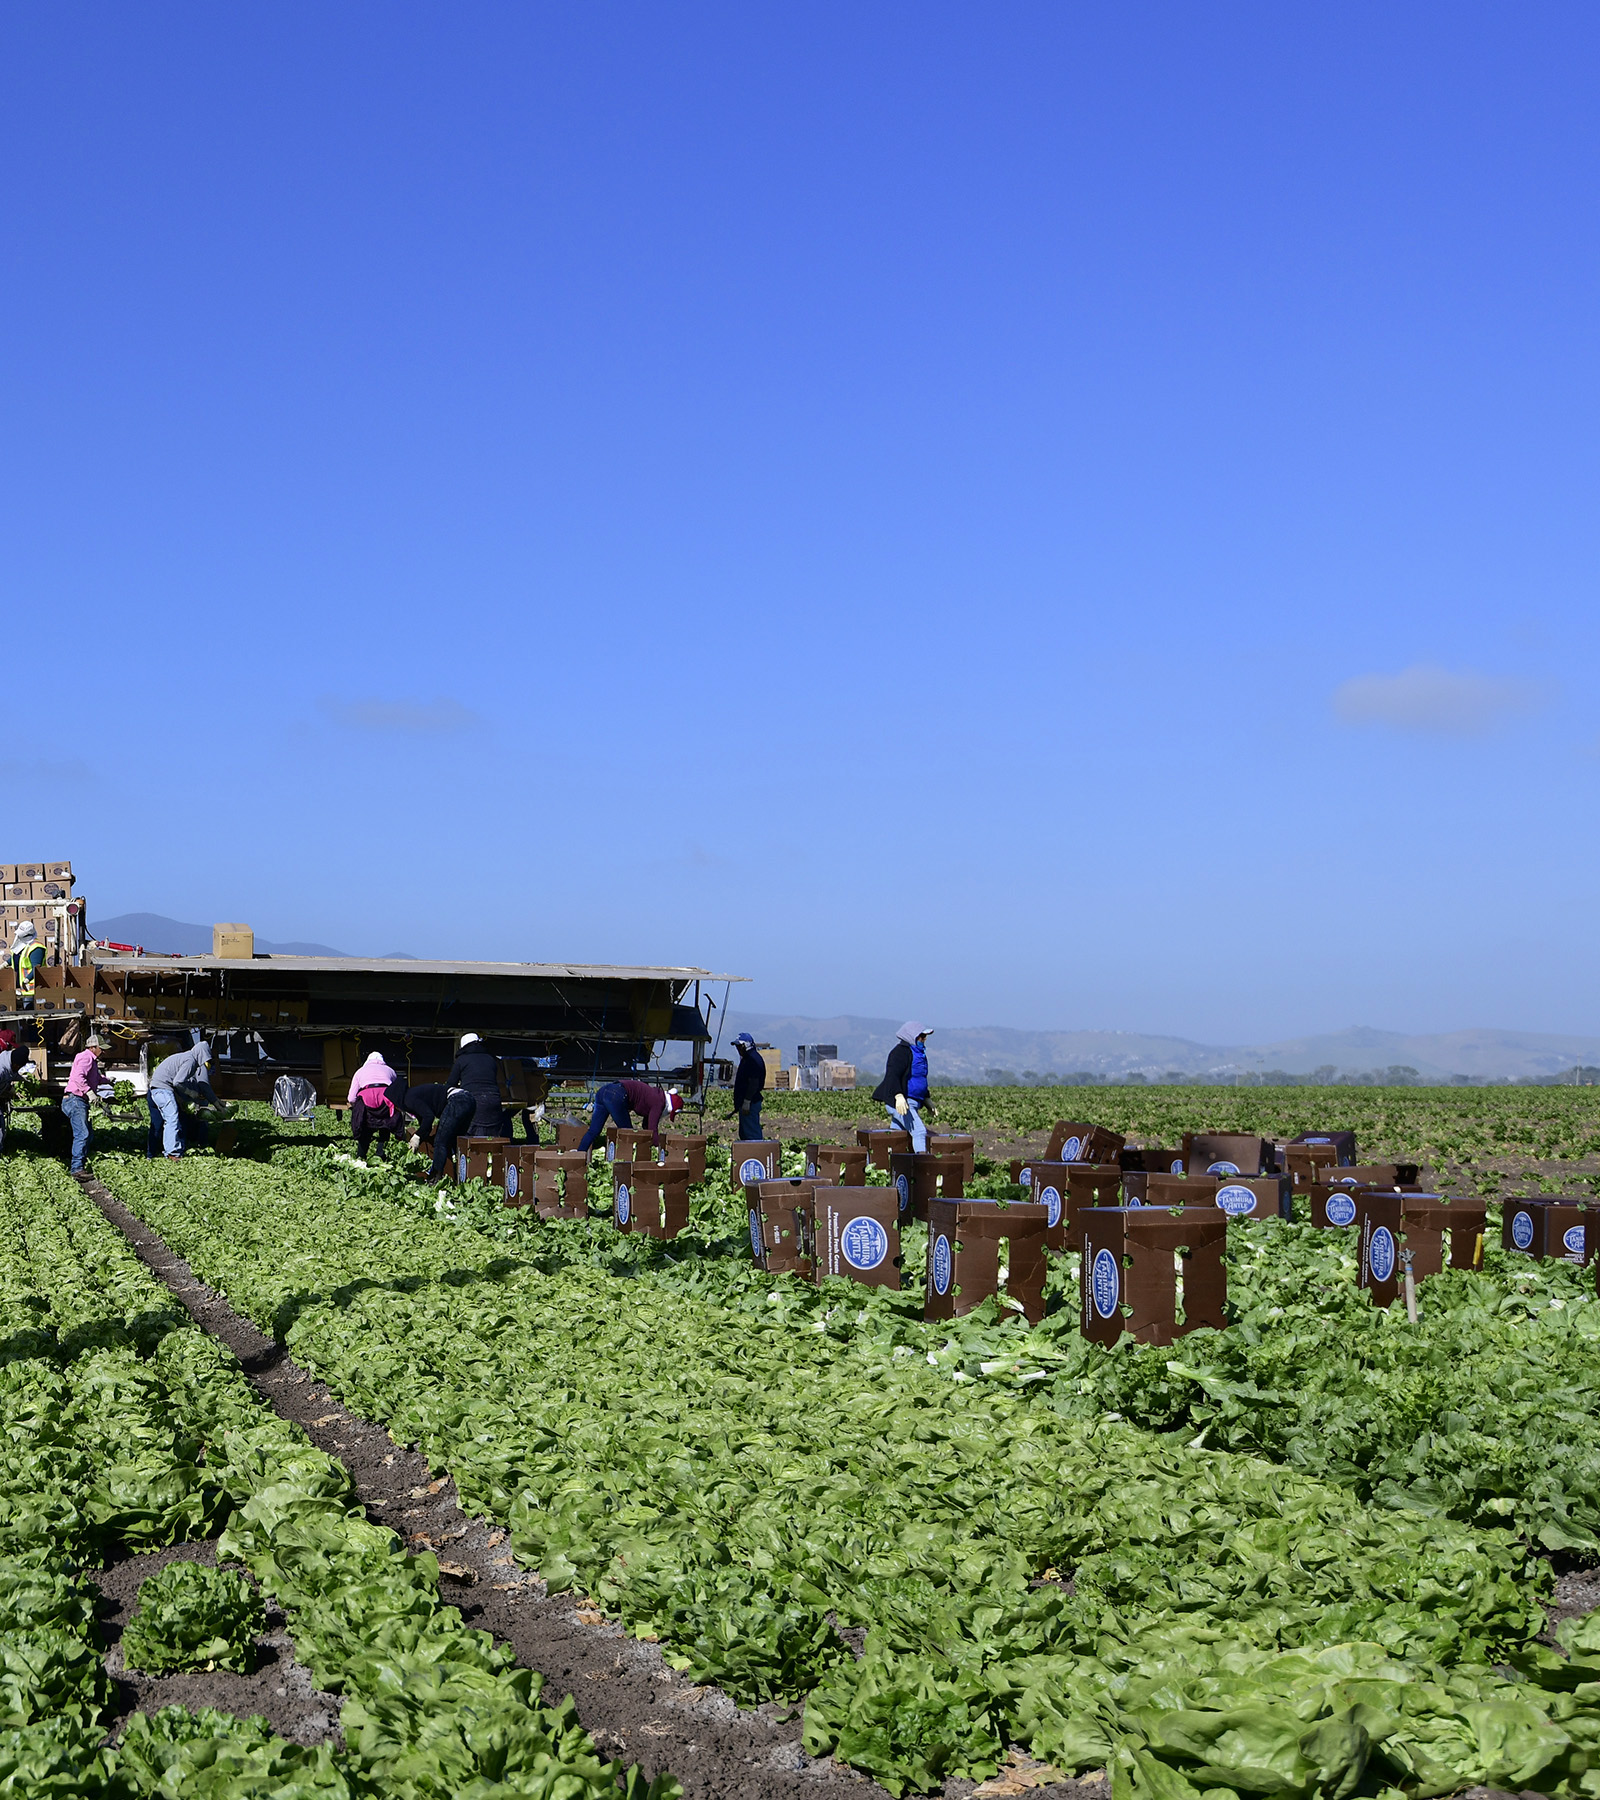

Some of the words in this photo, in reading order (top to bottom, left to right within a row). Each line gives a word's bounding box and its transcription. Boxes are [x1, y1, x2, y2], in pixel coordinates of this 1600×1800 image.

[1218, 1196, 1253, 1205] TANIMURA
[1227, 1202, 1248, 1211] ANTLE
[848, 1230, 861, 1259] ANTLE
[856, 1220, 872, 1265] TANIMURA
[1378, 1229, 1386, 1276] TANIMURA
[1100, 1253, 1109, 1312] TANIMURA
